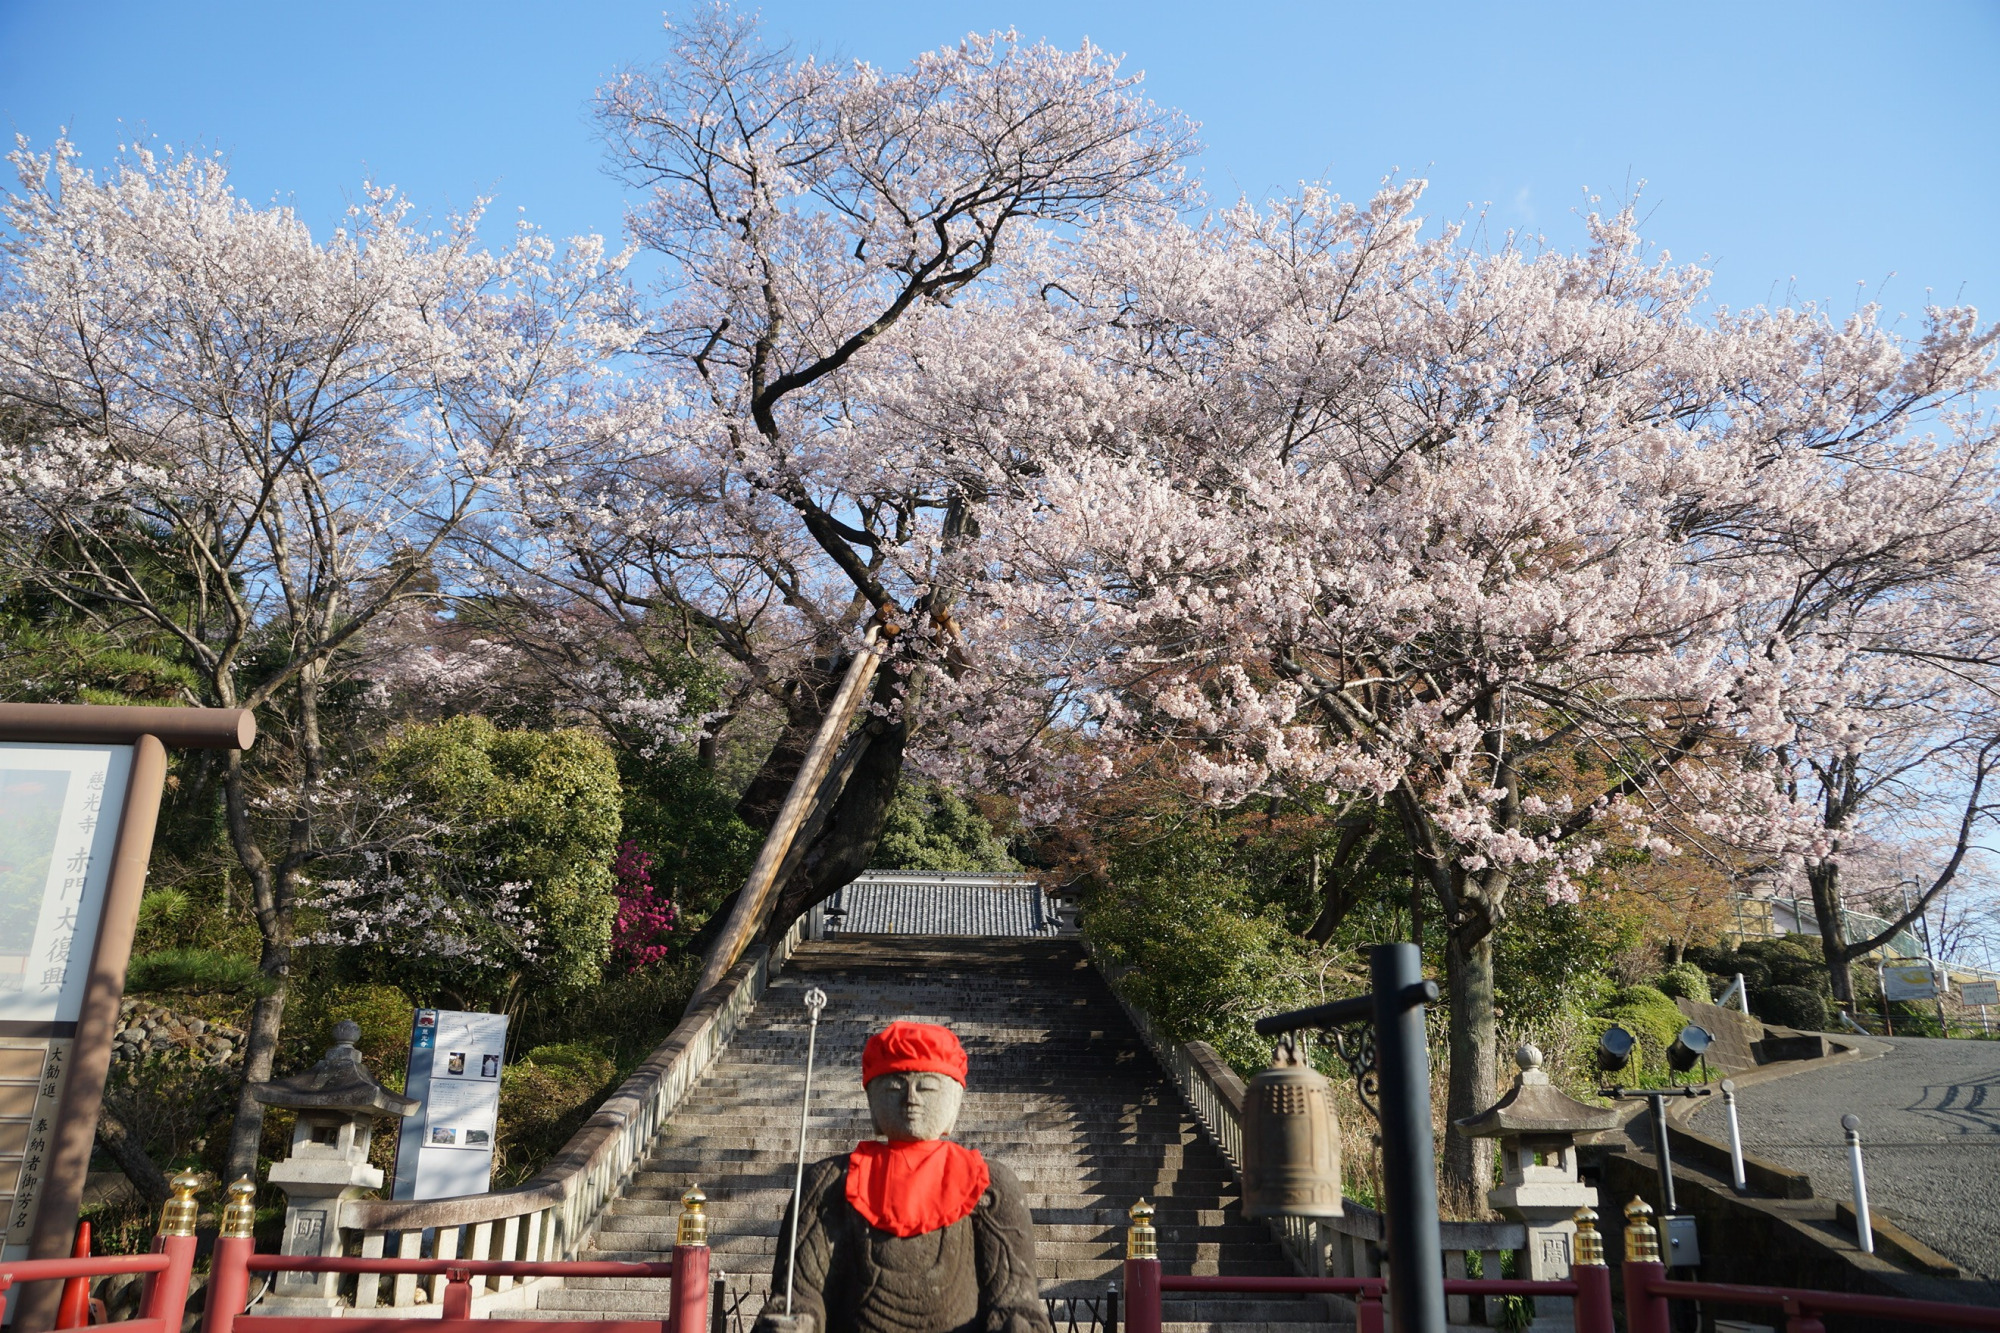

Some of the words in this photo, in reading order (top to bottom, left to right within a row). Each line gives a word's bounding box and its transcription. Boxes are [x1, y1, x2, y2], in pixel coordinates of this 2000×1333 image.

[77, 770, 106, 834] 慈光寺
[40, 846, 94, 993] 赤門大復興
[42, 1046, 63, 1098] 大勧進
[12, 1118, 48, 1229] 奉納者御芳名
